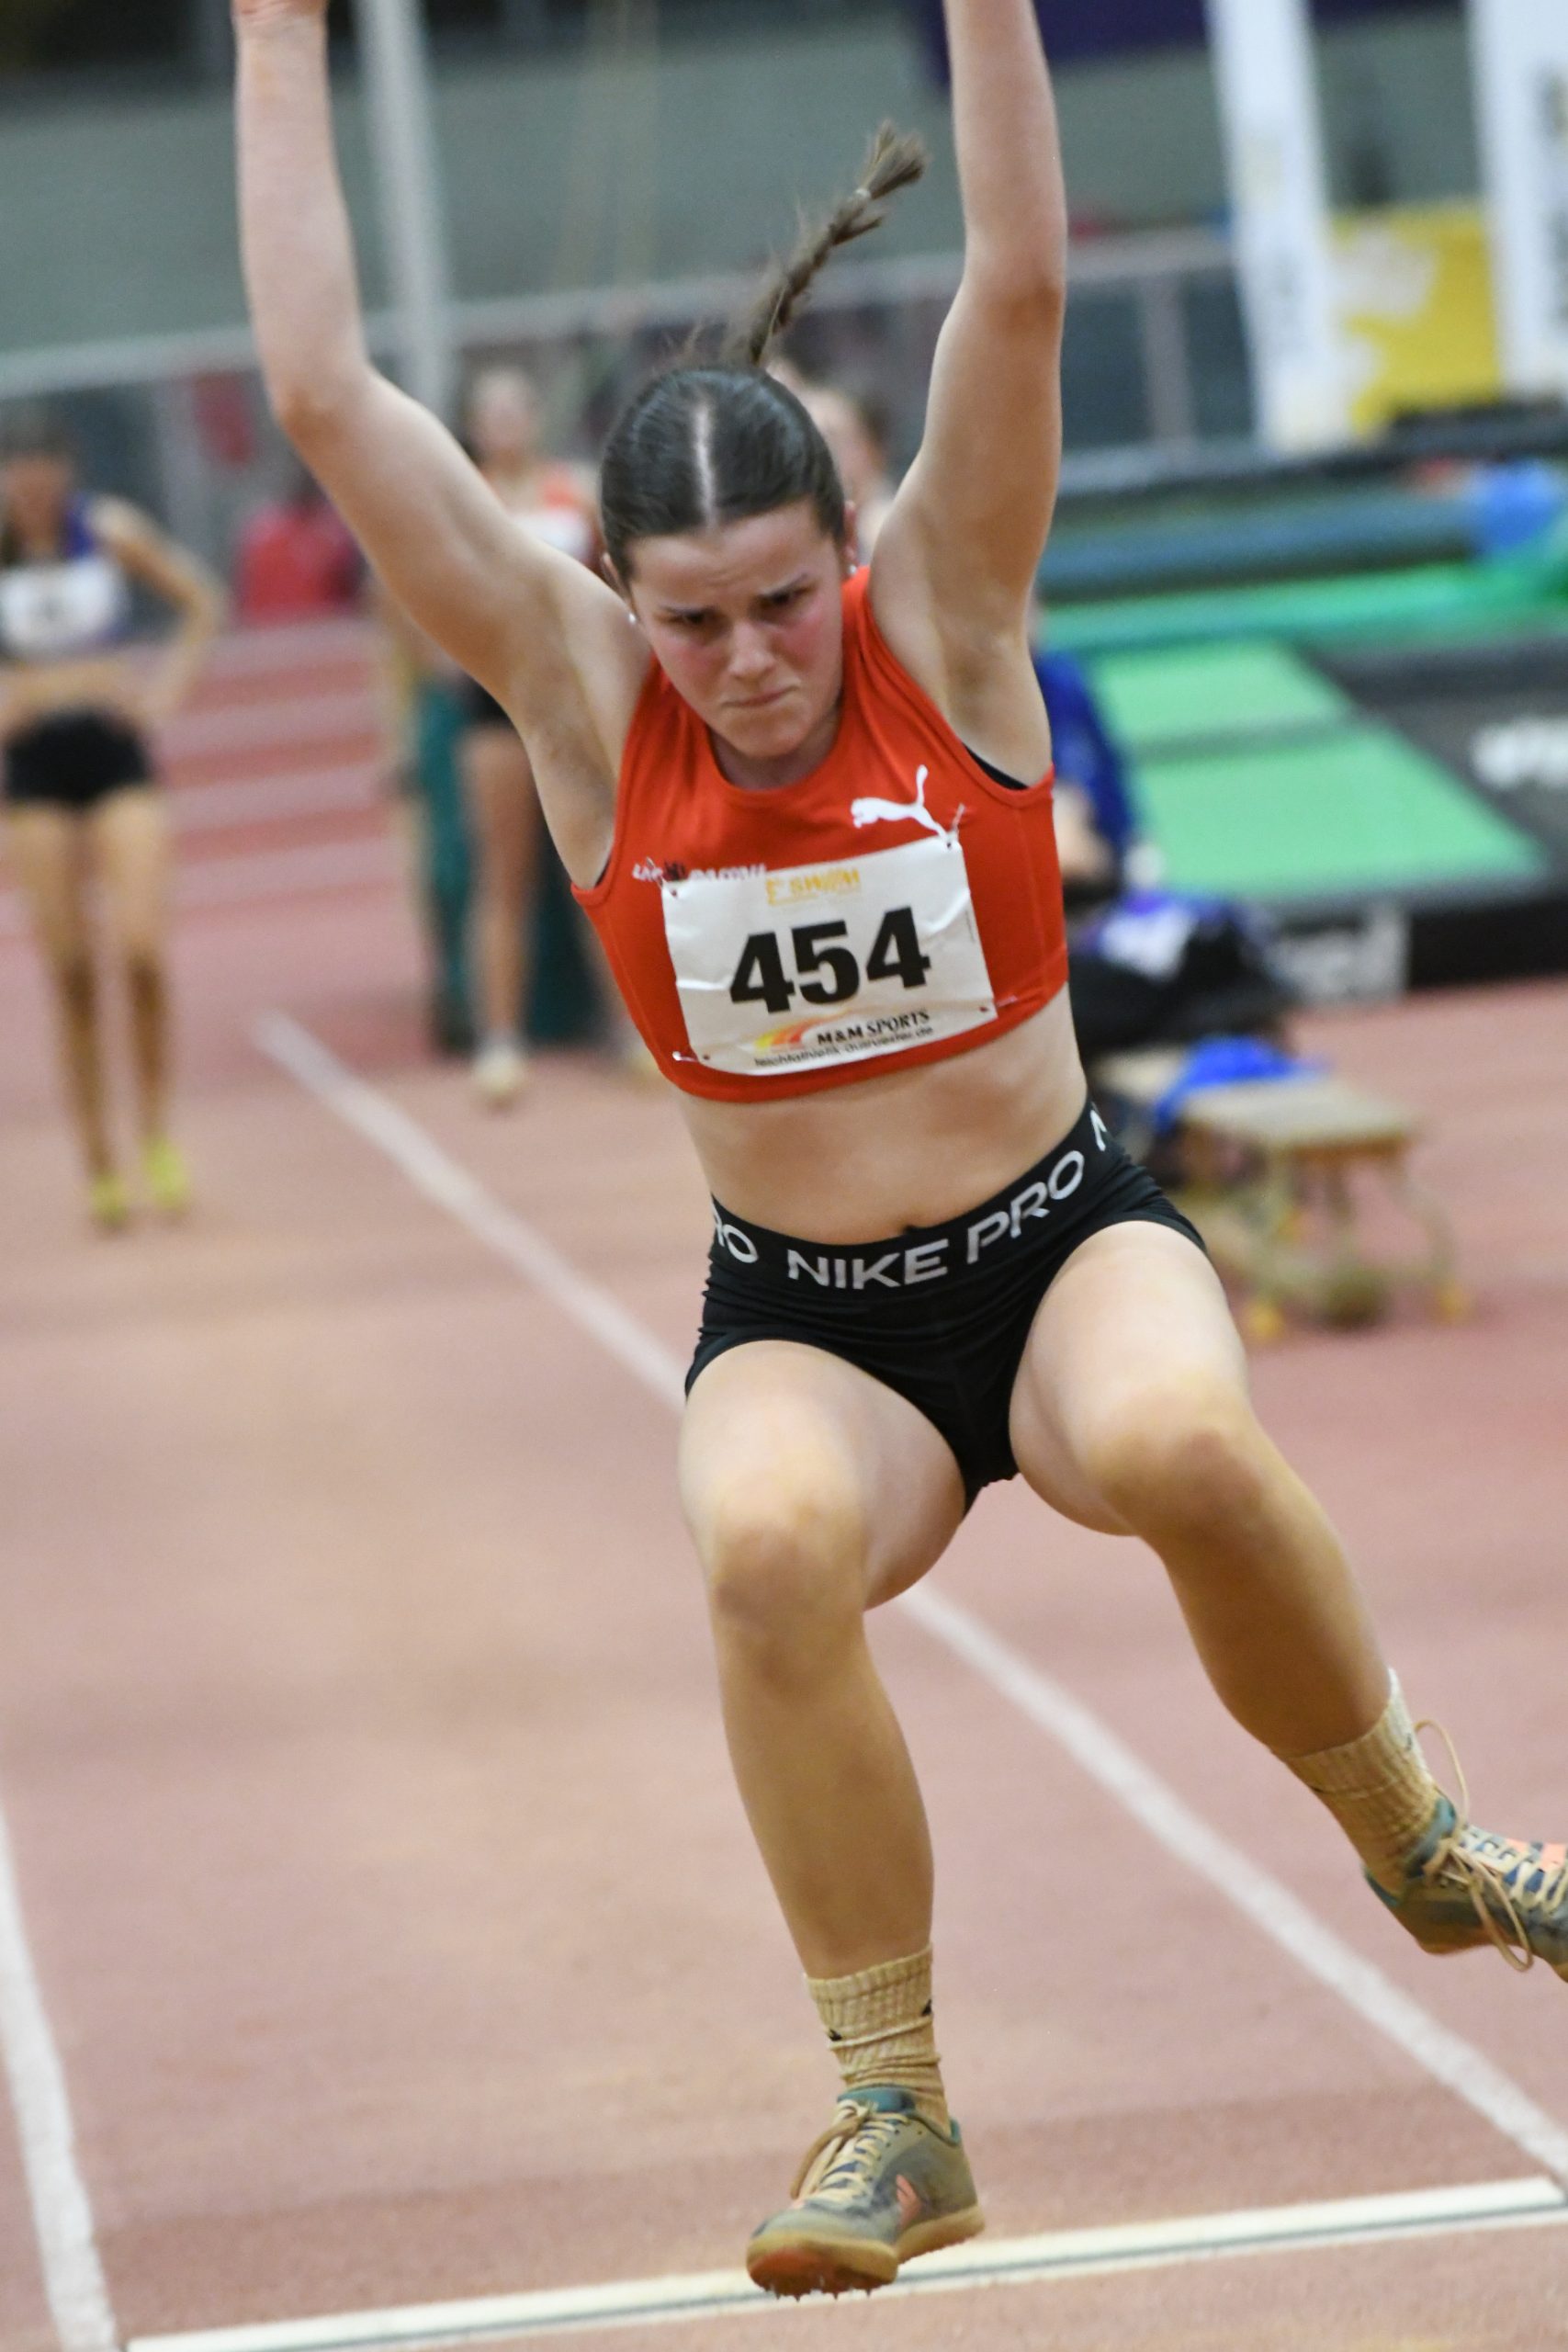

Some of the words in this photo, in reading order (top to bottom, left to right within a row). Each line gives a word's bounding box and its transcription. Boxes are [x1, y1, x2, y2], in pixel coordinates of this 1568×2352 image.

[730, 905, 931, 1013] 454
[817, 1025, 868, 1046] M&M
[866, 1008, 931, 1035] SPORTS
[787, 1238, 949, 1290] NIKE
[966, 1149, 1084, 1264] PRO
